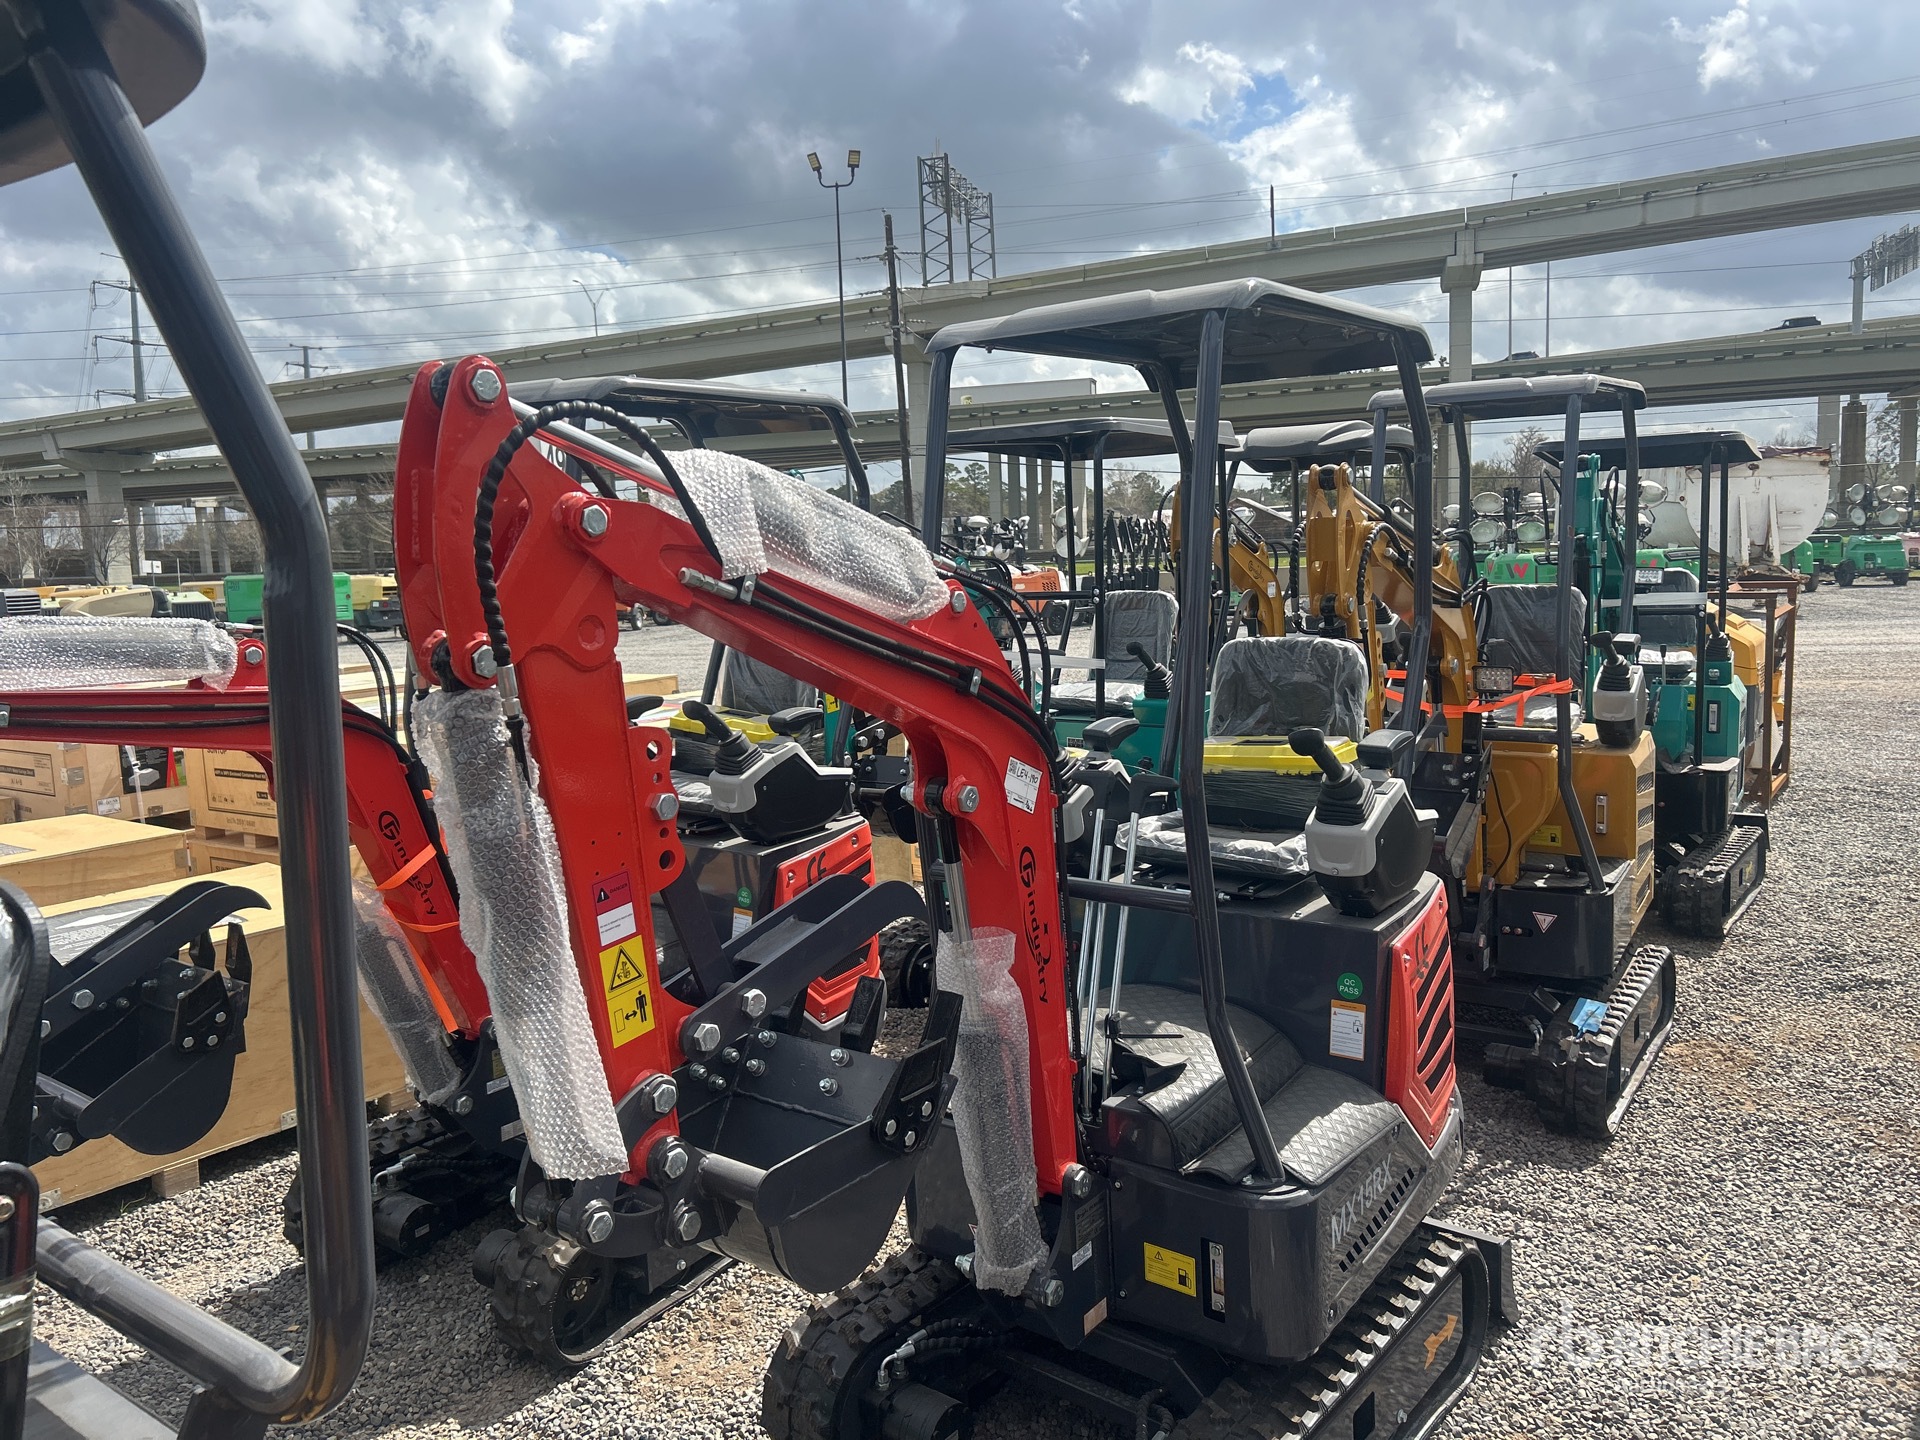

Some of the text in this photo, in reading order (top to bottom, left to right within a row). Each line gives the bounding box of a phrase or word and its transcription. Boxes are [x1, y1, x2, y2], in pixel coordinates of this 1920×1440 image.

[609, 882, 628, 894] DANGER
[1343, 978, 1356, 986] QC
[1339, 985, 1359, 995] PASS
